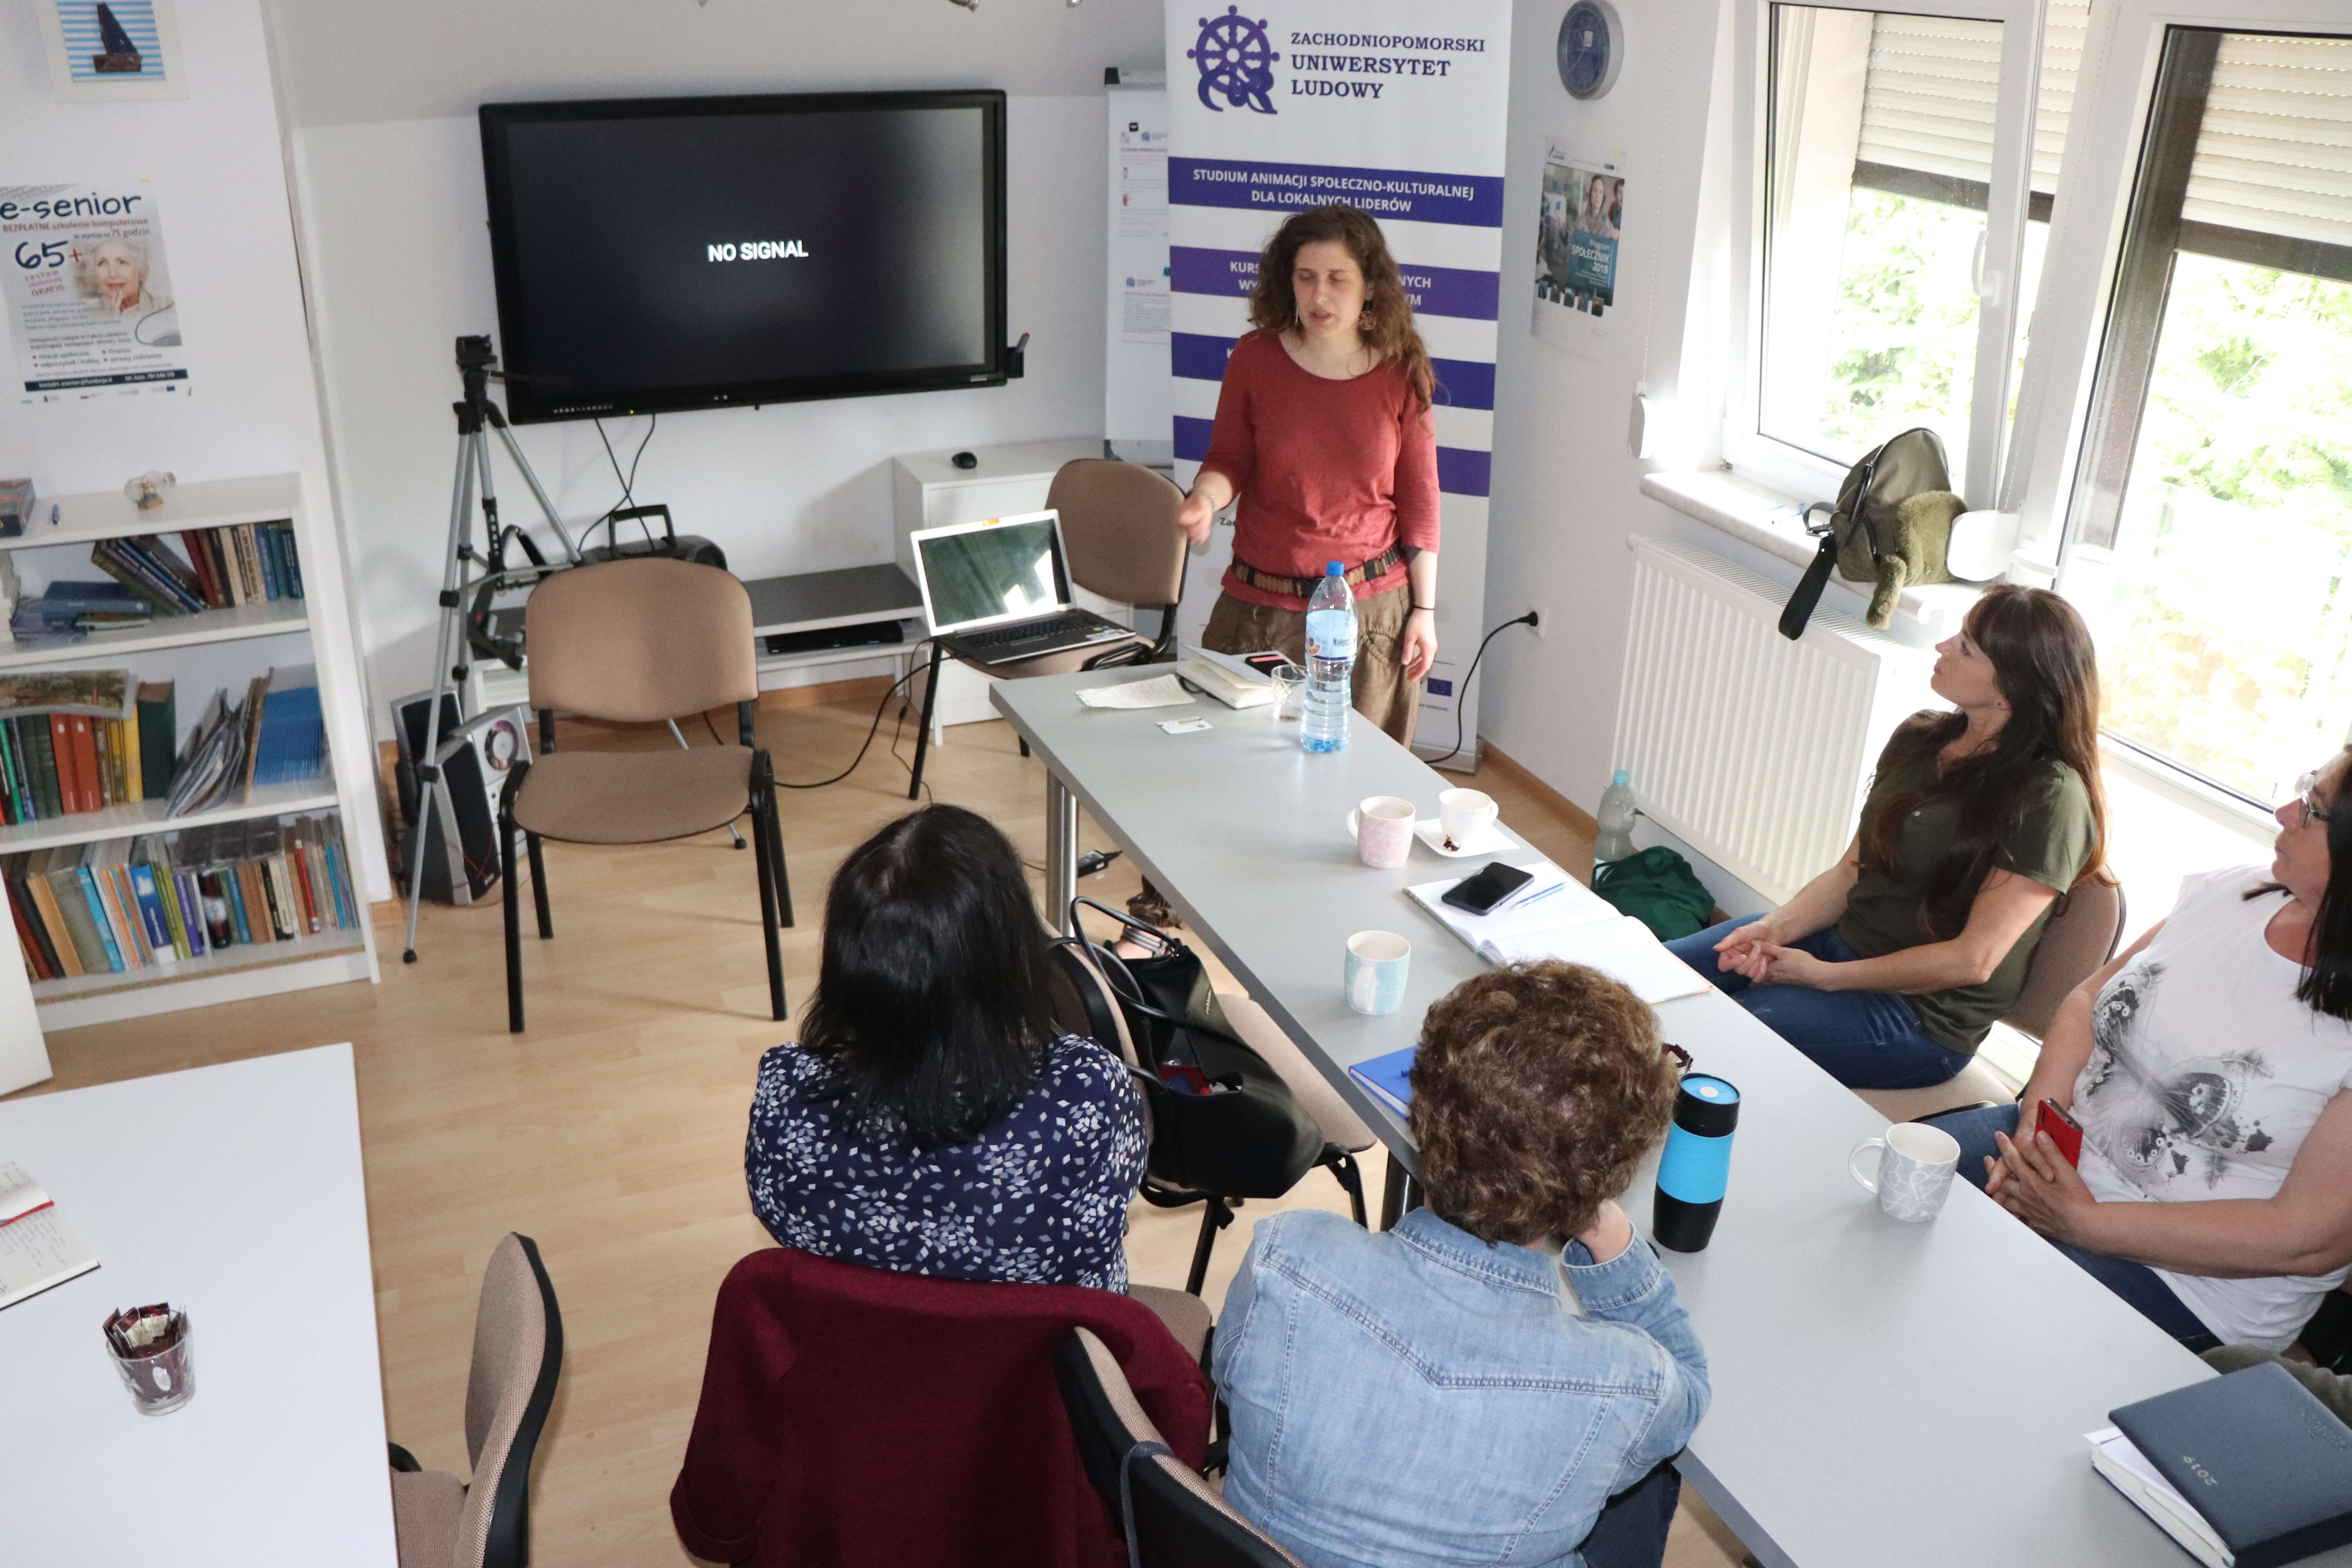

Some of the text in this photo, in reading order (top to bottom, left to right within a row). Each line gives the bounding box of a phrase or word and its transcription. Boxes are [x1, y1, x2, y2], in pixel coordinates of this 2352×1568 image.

[1292, 32, 1485, 52] ZACHODNIOPOMORSKI
[1292, 54, 1451, 76] UNIWERSYTET
[1292, 80, 1383, 98] LUDOWY
[1193, 169, 1474, 201] STUDIUM ANIMACJI SPOŁECZNO-KULTURALNEJ
[0, 192, 142, 220] e-senior
[1251, 191, 1412, 212] DLA LOKALNYCH LIDERÓW
[92, 218, 149, 229] komputerowe
[708, 240, 809, 262] NO SIGNAL
[1230, 261, 1432, 289] KURS NYCH
[2183, 1456, 2218, 1486] 2019
